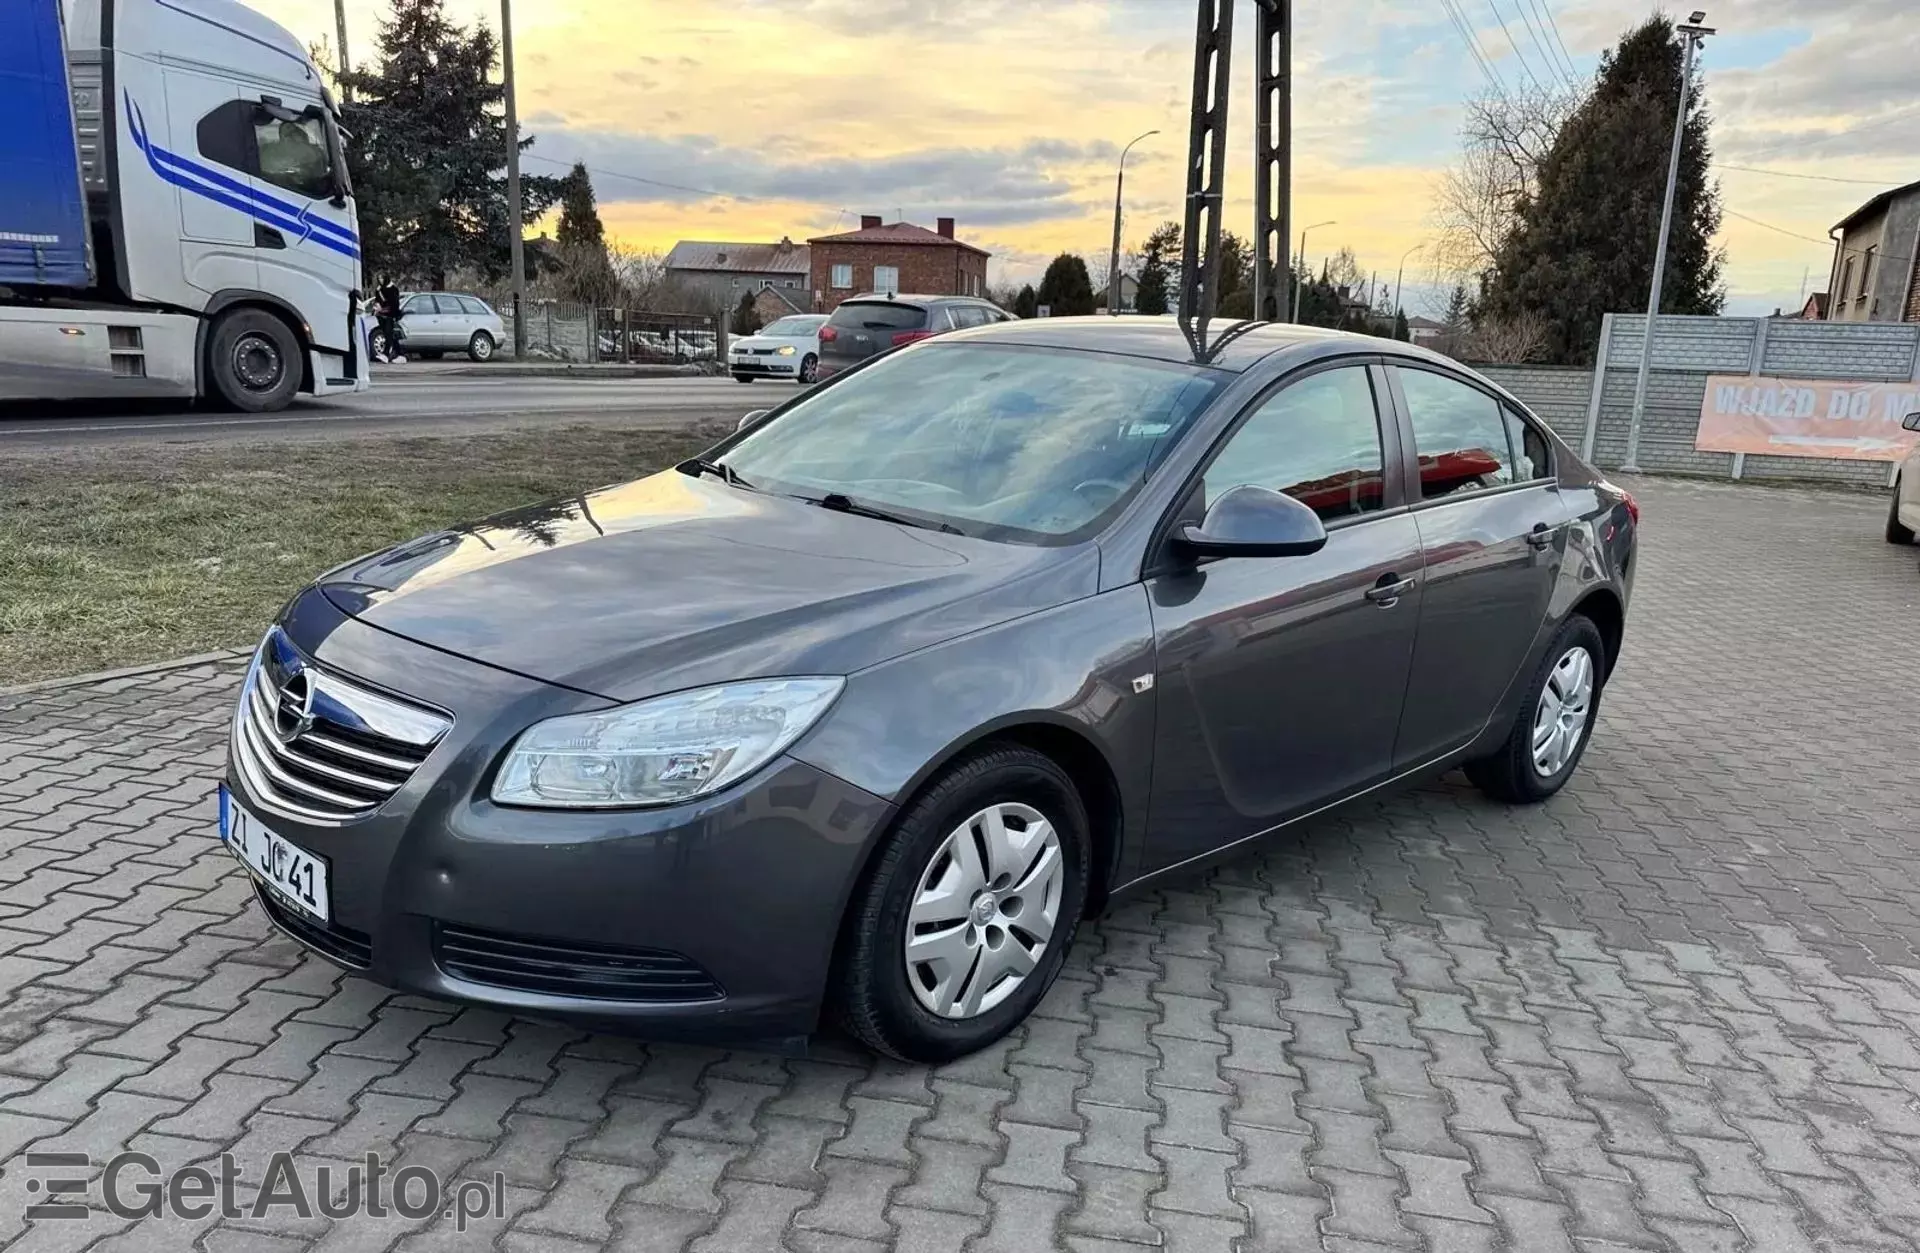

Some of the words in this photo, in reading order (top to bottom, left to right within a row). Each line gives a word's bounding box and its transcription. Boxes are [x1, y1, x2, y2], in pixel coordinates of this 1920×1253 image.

[1715, 384, 1816, 418] WJAZD
[1826, 389, 1871, 421] DO
[1884, 392, 1920, 421] M
[288, 854, 317, 907] 41
